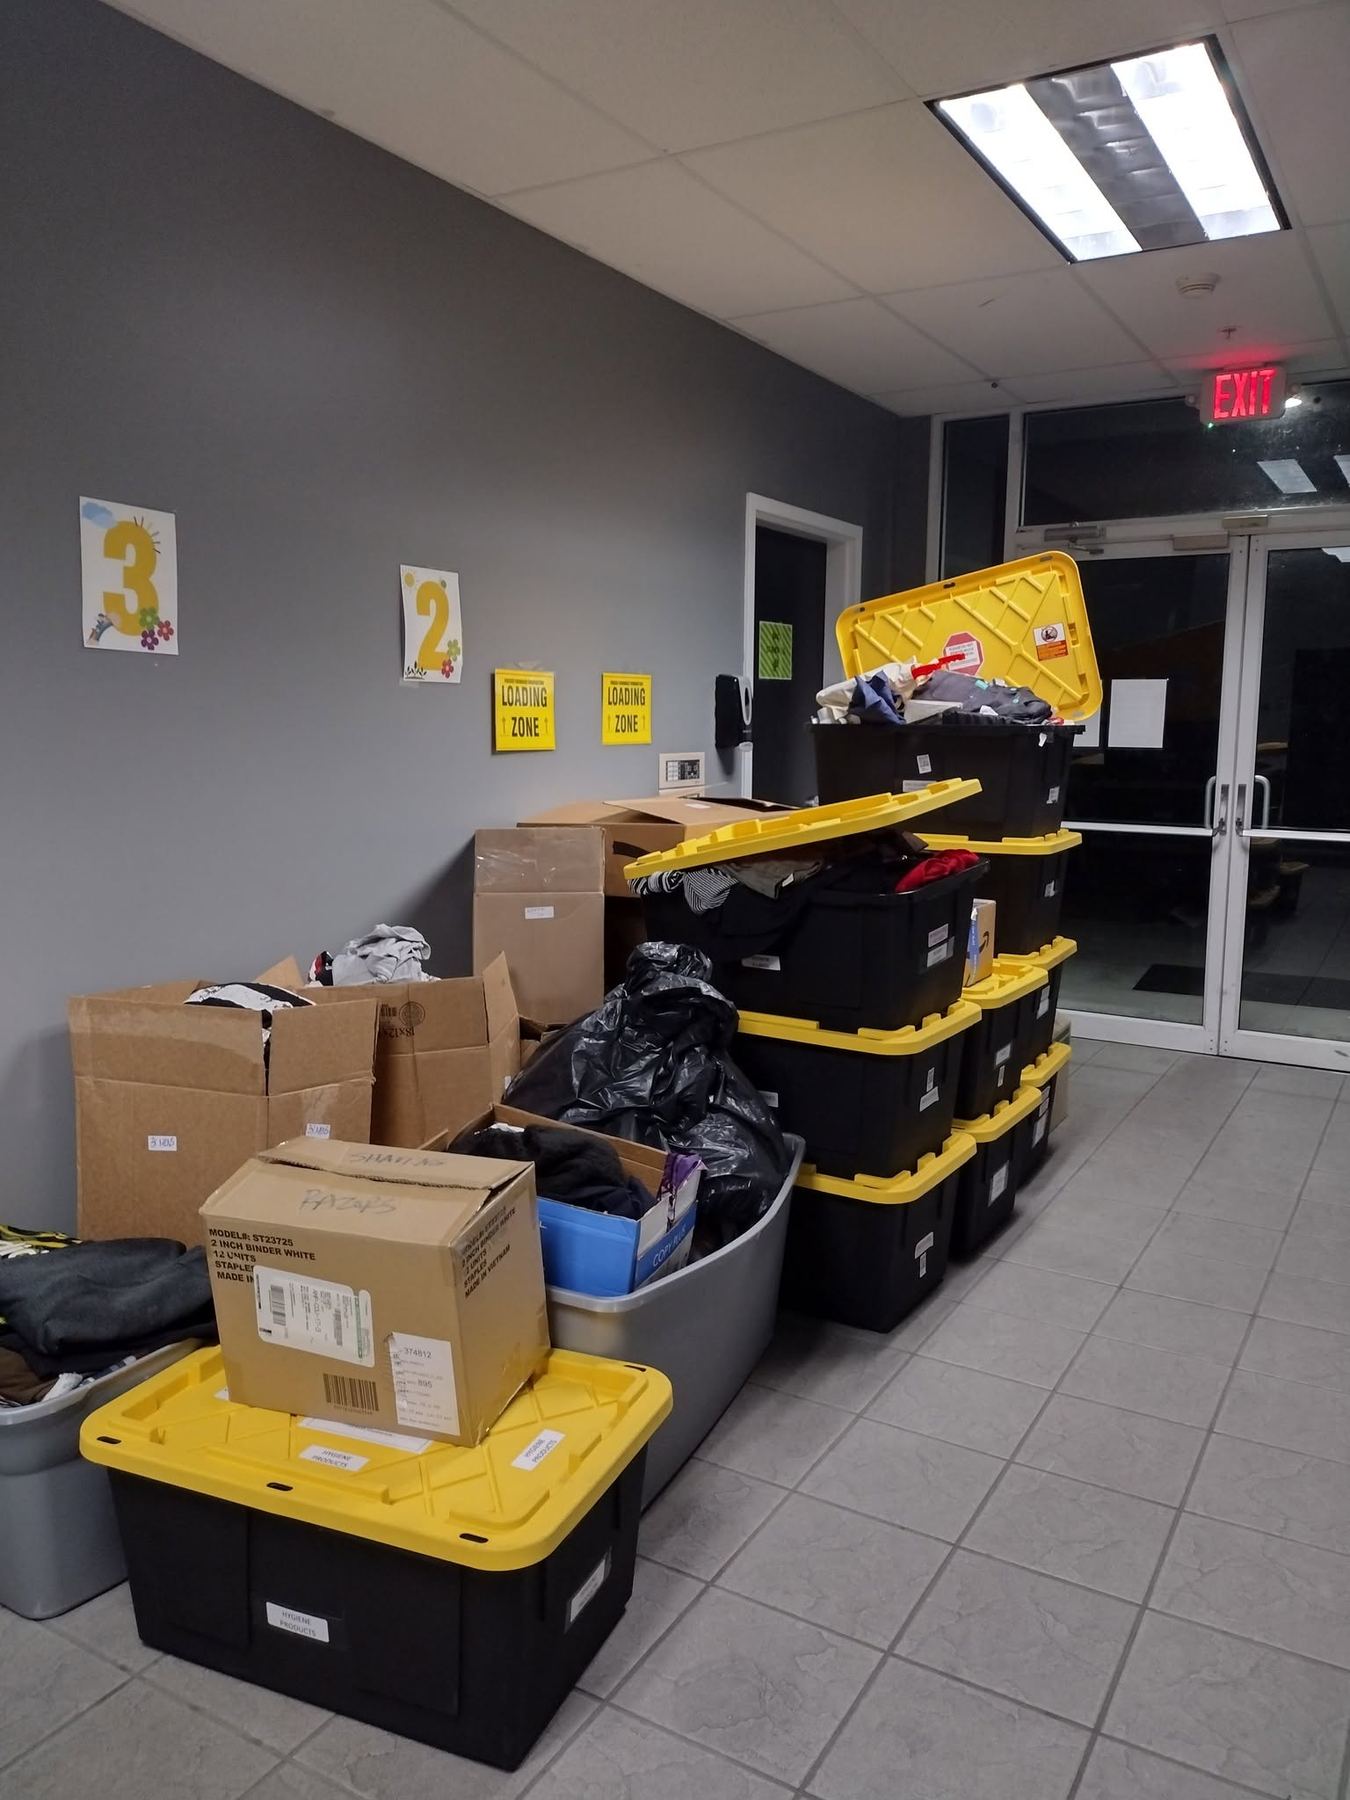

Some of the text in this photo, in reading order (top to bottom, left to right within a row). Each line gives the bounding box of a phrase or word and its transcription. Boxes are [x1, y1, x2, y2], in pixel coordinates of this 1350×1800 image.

[1213, 369, 1276, 418] EXIT
[103, 520, 159, 637] 3
[416, 580, 450, 670] 2
[501, 684, 548, 708] LOADING
[607, 686, 646, 706] LOADING
[511, 716, 540, 738] ZONE
[614, 714, 639, 733] ZONE
[209, 1229, 294, 1247] MODEL#: ST23725
[211, 1239, 316, 1260] 2 INCH BINDER WHITE
[214, 1250, 257, 1263] 12 UNITS
[466, 1245, 480, 1264] INCH
[470, 1248, 487, 1270] UNITS
[653, 1243, 671, 1267] COPY
[217, 1271, 244, 1283] MADE
[464, 1259, 487, 1288] STAPLES
[465, 1244, 510, 1298] MADE IN VIETNAM
[282, 1610, 311, 1626] HYGIENE
[279, 1620, 317, 1638] PRODUCTS
